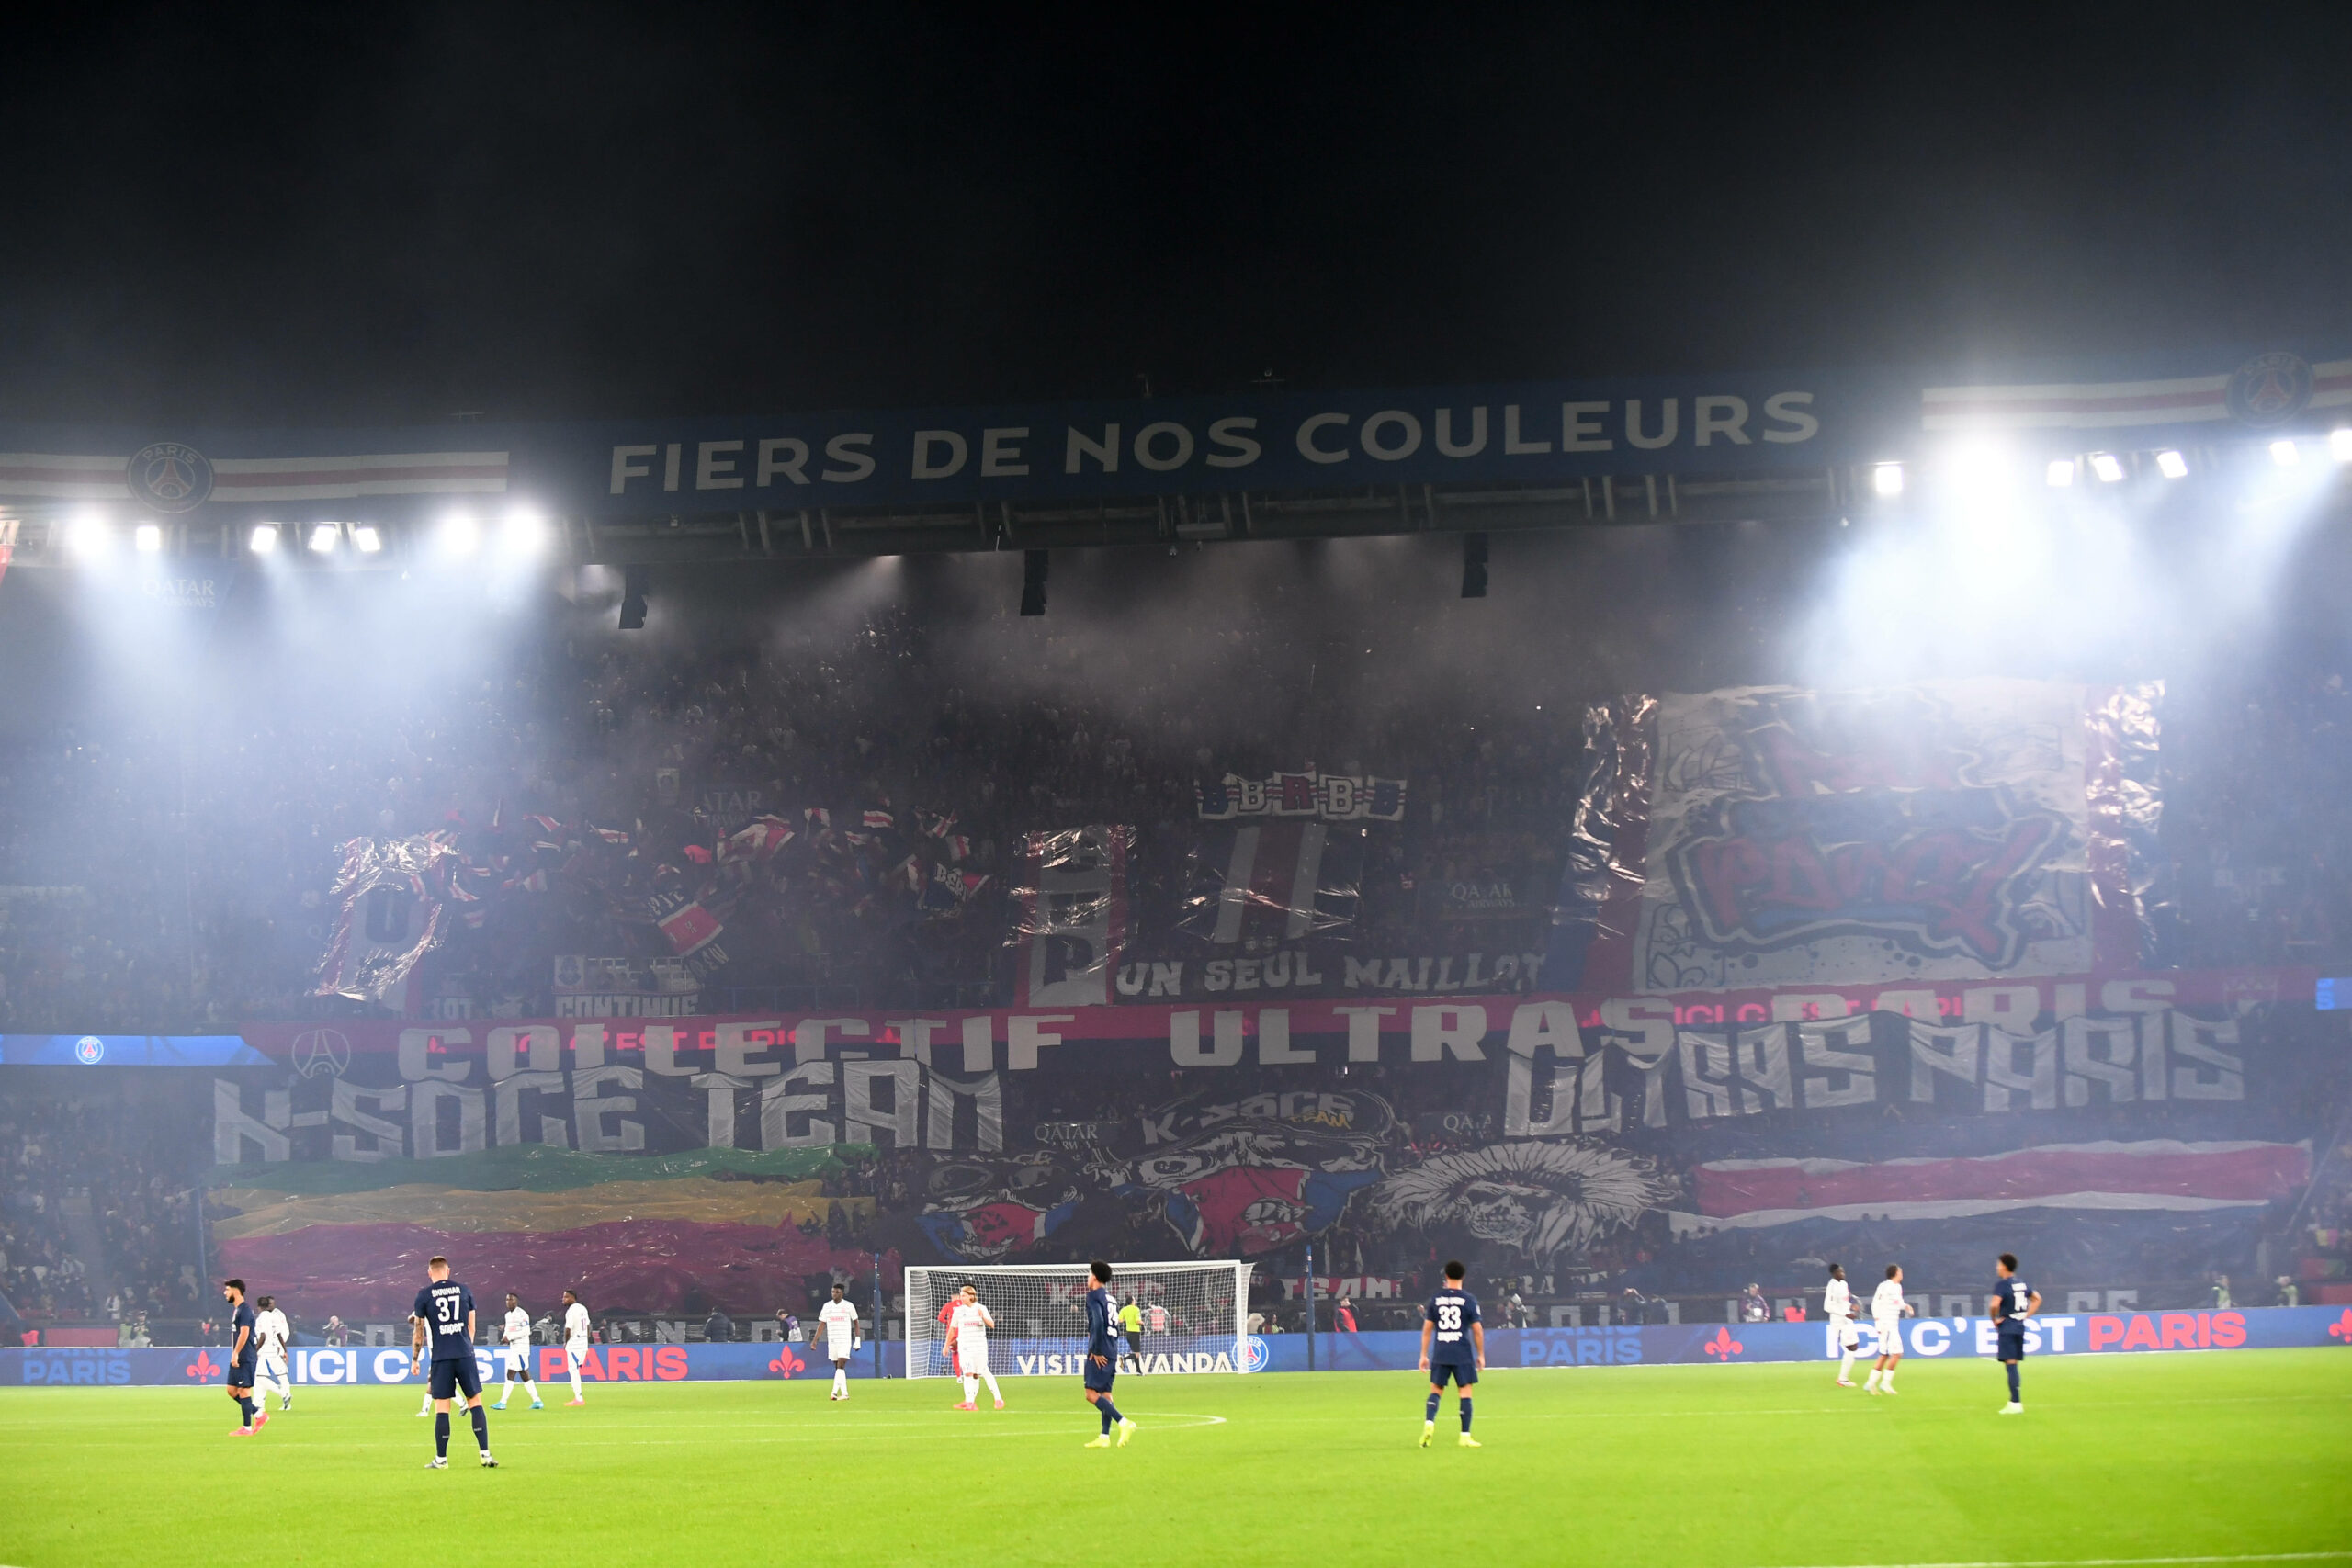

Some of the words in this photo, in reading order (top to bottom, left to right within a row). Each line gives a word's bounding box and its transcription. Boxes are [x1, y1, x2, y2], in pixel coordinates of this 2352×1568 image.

[143, 445, 198, 464] PARIS
[609, 433, 877, 494] FIERS
[911, 426, 1030, 479] DE
[1065, 417, 1262, 474] NOS
[1296, 391, 1819, 464] COULEURS
[701, 790, 762, 812] ATAR
[1452, 882, 1514, 902] QAAR
[1115, 960, 1184, 997] UN
[1204, 952, 1322, 992] SEUL
[398, 1014, 1076, 1082] COLLECTIF
[1170, 998, 1675, 1066] ULTRAS
[1908, 1011, 2245, 1111] PARIS
[690, 1058, 1003, 1151] TEAM
[1035, 1123, 1098, 1144] QATAR
[435, 1295, 460, 1322] 37
[1438, 1305, 1462, 1330] 33
[1826, 1324, 1879, 1359] IC
[2089, 1312, 2247, 1351] PARIS
[1016, 1354, 1090, 1375] VISIT
[1521, 1337, 1643, 1366] PARIS
[23, 1359, 131, 1384] PARIS
[296, 1350, 357, 1383] ICI
[373, 1349, 509, 1385] C'ST
[540, 1347, 689, 1382] PARIS
